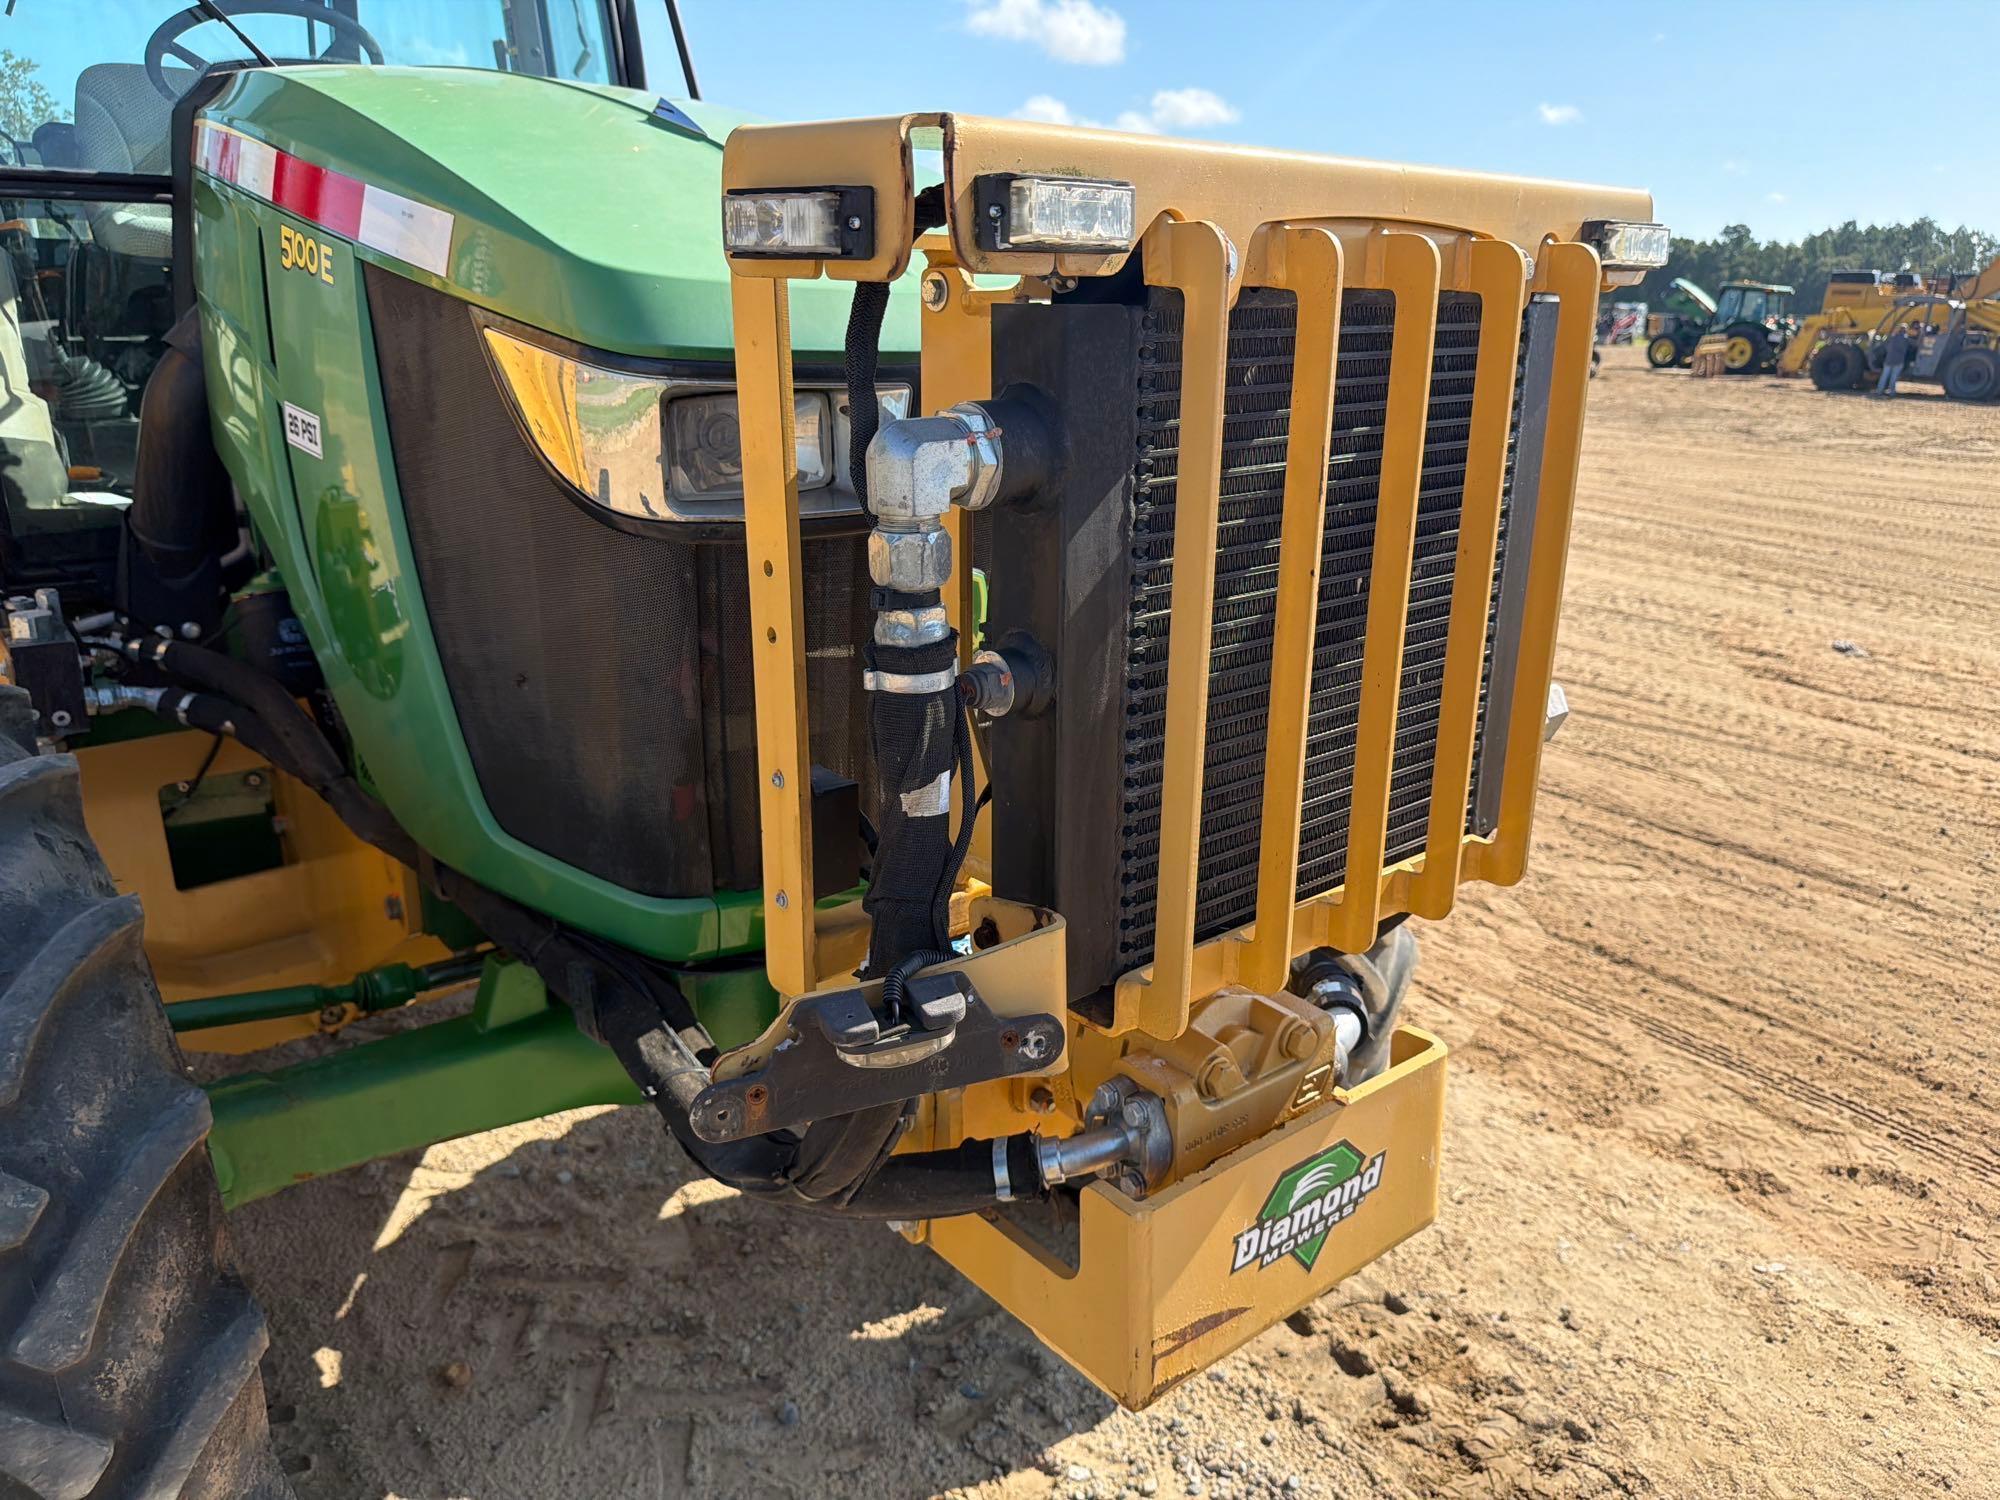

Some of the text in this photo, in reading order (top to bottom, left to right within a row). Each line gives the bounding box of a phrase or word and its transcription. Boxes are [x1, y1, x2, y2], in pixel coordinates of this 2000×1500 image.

[300, 418, 318, 446] PSI
[1233, 1155, 1384, 1270] Diamond
[1262, 1206, 1355, 1266] MOWERS
